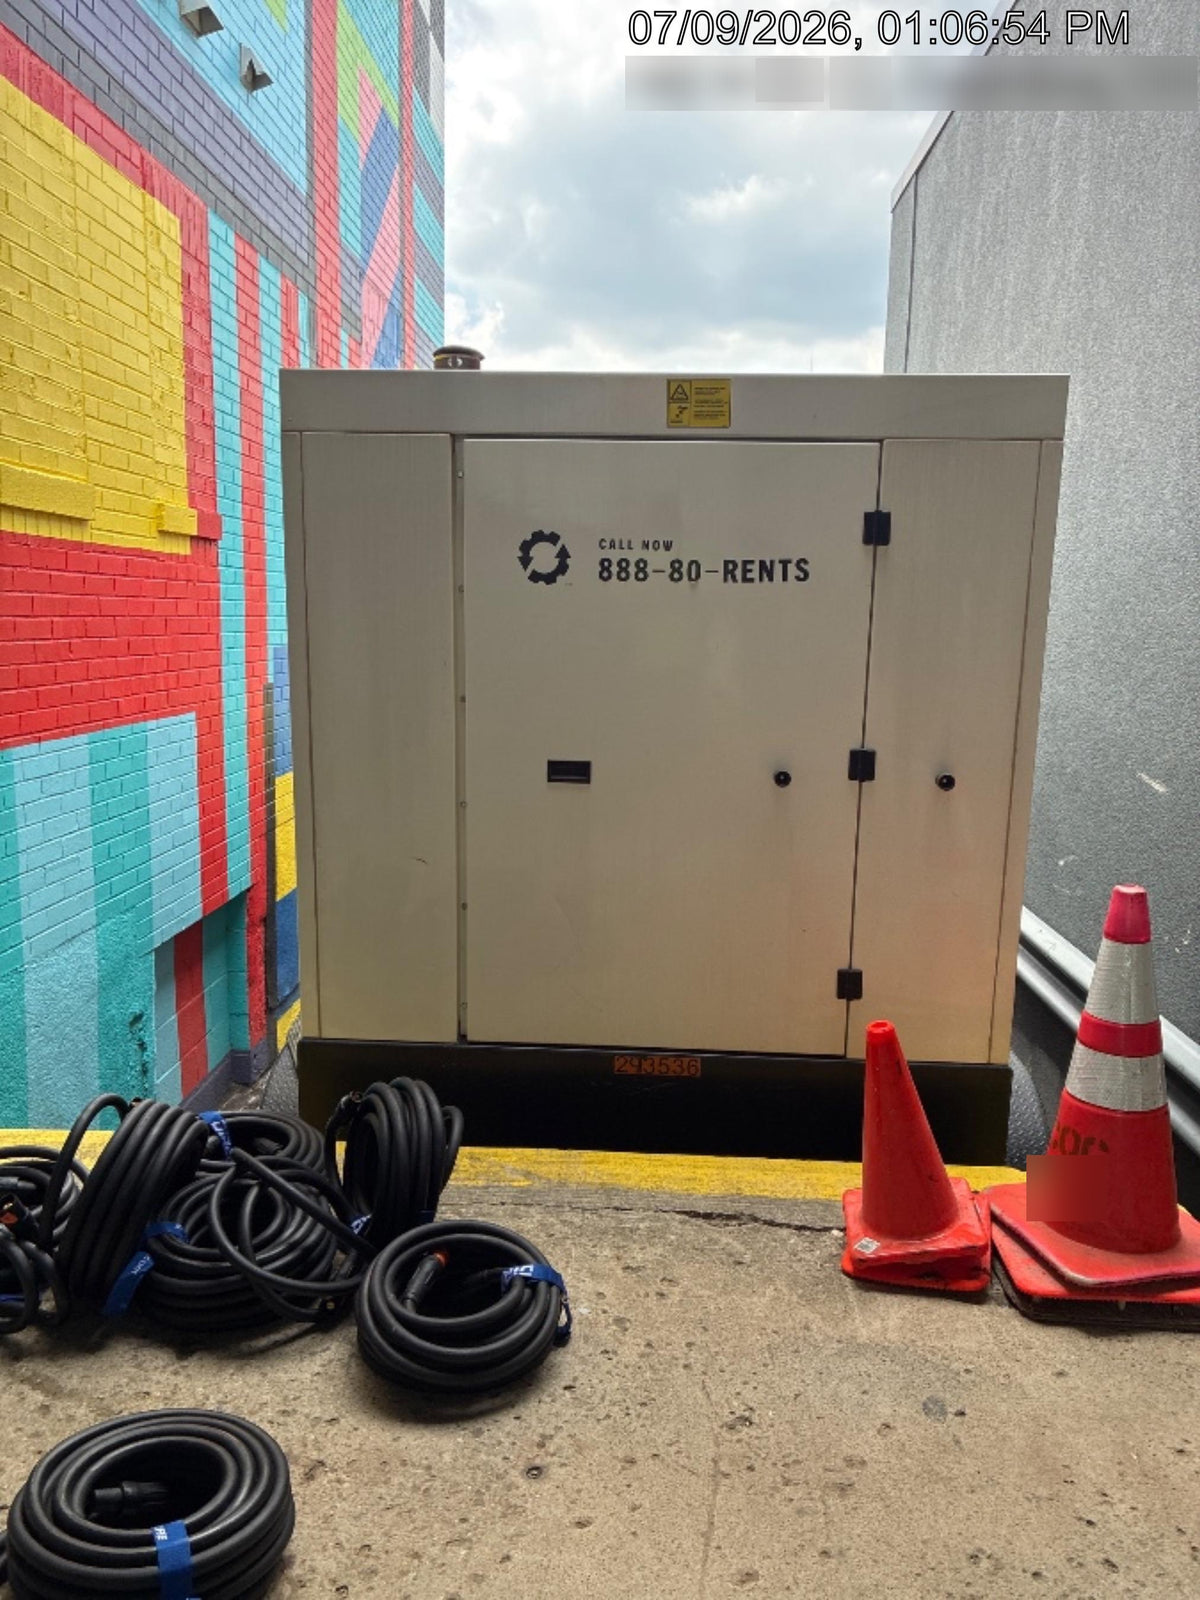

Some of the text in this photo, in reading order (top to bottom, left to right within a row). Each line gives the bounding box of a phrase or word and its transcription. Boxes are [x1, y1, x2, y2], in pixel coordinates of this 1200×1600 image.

[599, 538, 673, 551] CALL NOW
[599, 558, 810, 583] 888-80-RENTS
[615, 1056, 700, 1076] 293536
